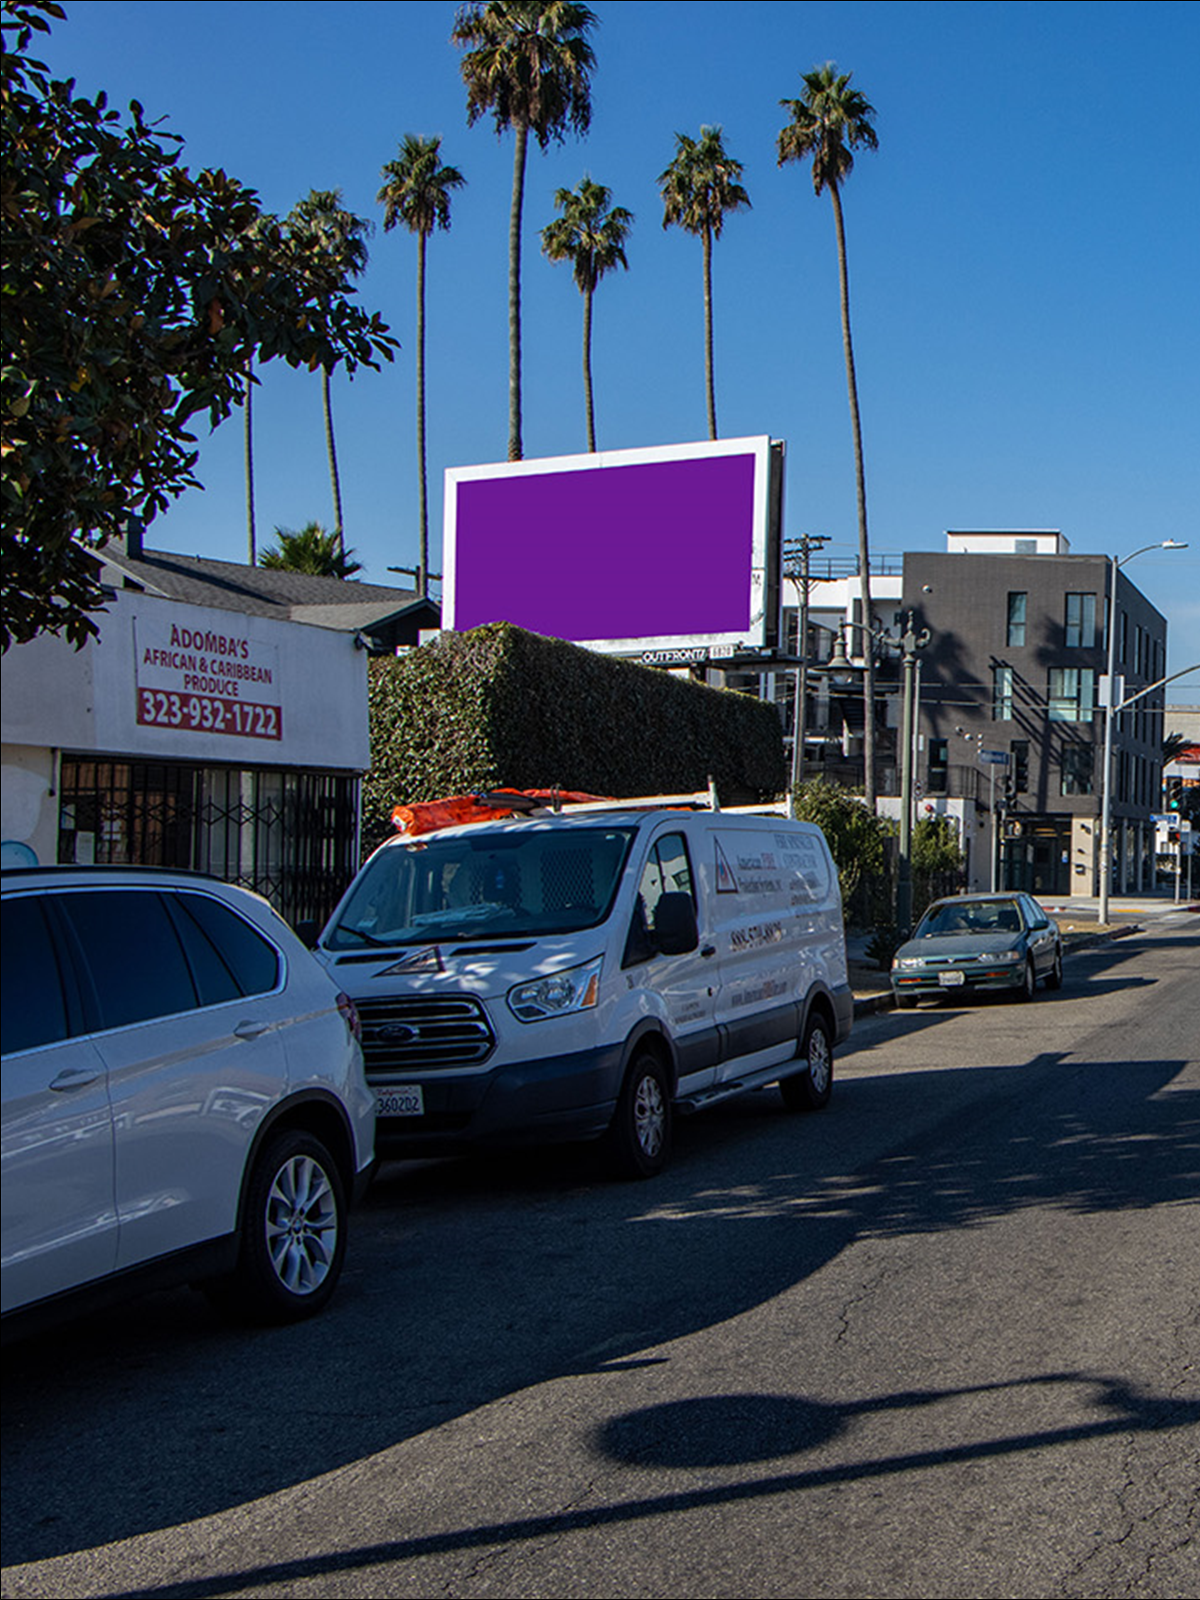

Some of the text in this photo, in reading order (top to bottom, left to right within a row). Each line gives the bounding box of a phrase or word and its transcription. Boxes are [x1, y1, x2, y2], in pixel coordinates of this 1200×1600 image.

[170, 625, 249, 660] ADOMBA'S
[143, 648, 273, 684] AFRICAN & CARIBBEAN
[183, 673, 239, 697] PRODUCE
[142, 691, 277, 736] 323-932-1722
